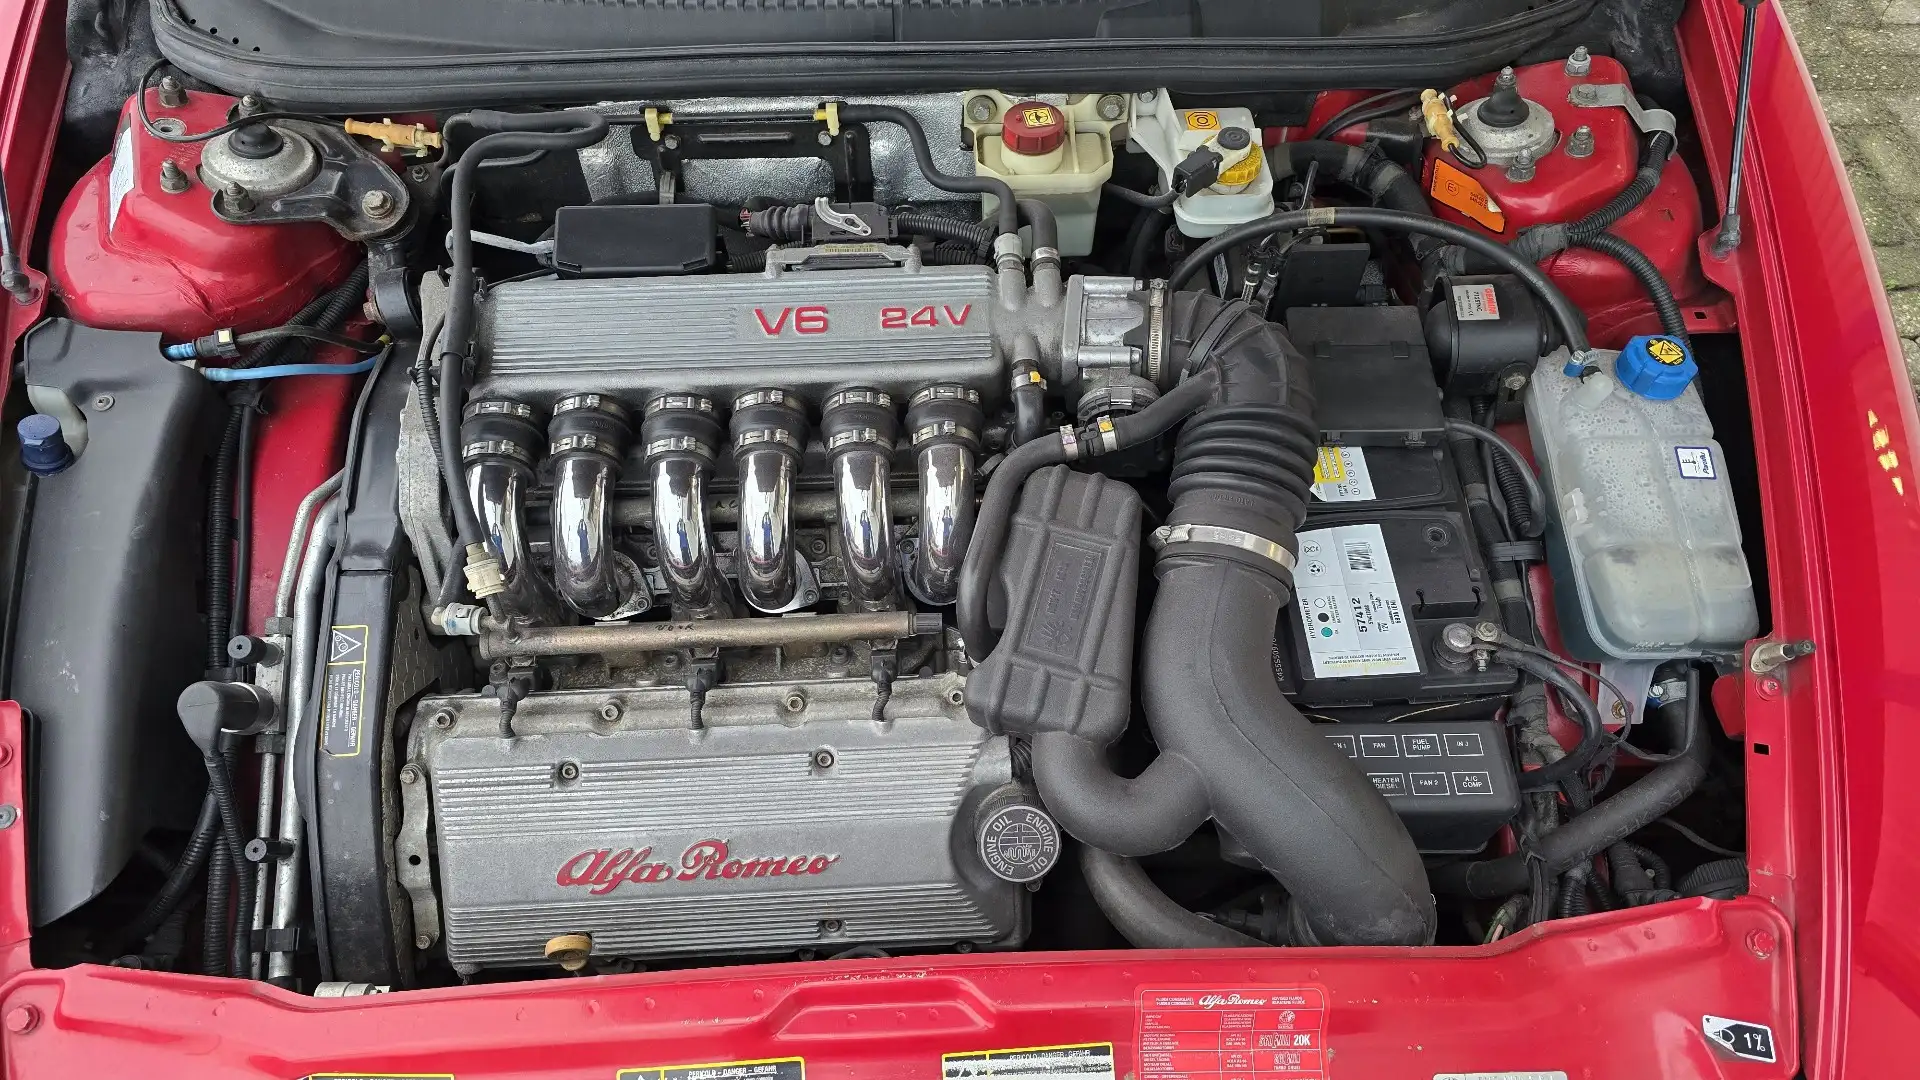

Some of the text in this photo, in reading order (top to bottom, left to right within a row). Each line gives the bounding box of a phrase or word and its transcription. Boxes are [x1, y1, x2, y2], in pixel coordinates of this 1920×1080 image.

[754, 304, 972, 336] V6 24V
[1302, 598, 1316, 639] HYDROMETER
[1352, 597, 1368, 633] 57412
[986, 815, 1015, 876] ENGINE OIL
[1025, 812, 1054, 873] ENGINE OIL
[556, 838, 841, 895] Alfa Romeo
[1198, 993, 1268, 1009] Alfa Romeo
[1293, 1034, 1312, 1047] 20K
[1743, 1031, 1766, 1052] 1%
[688, 1065, 777, 1078] PERICOLO DANGER GEFAHR
